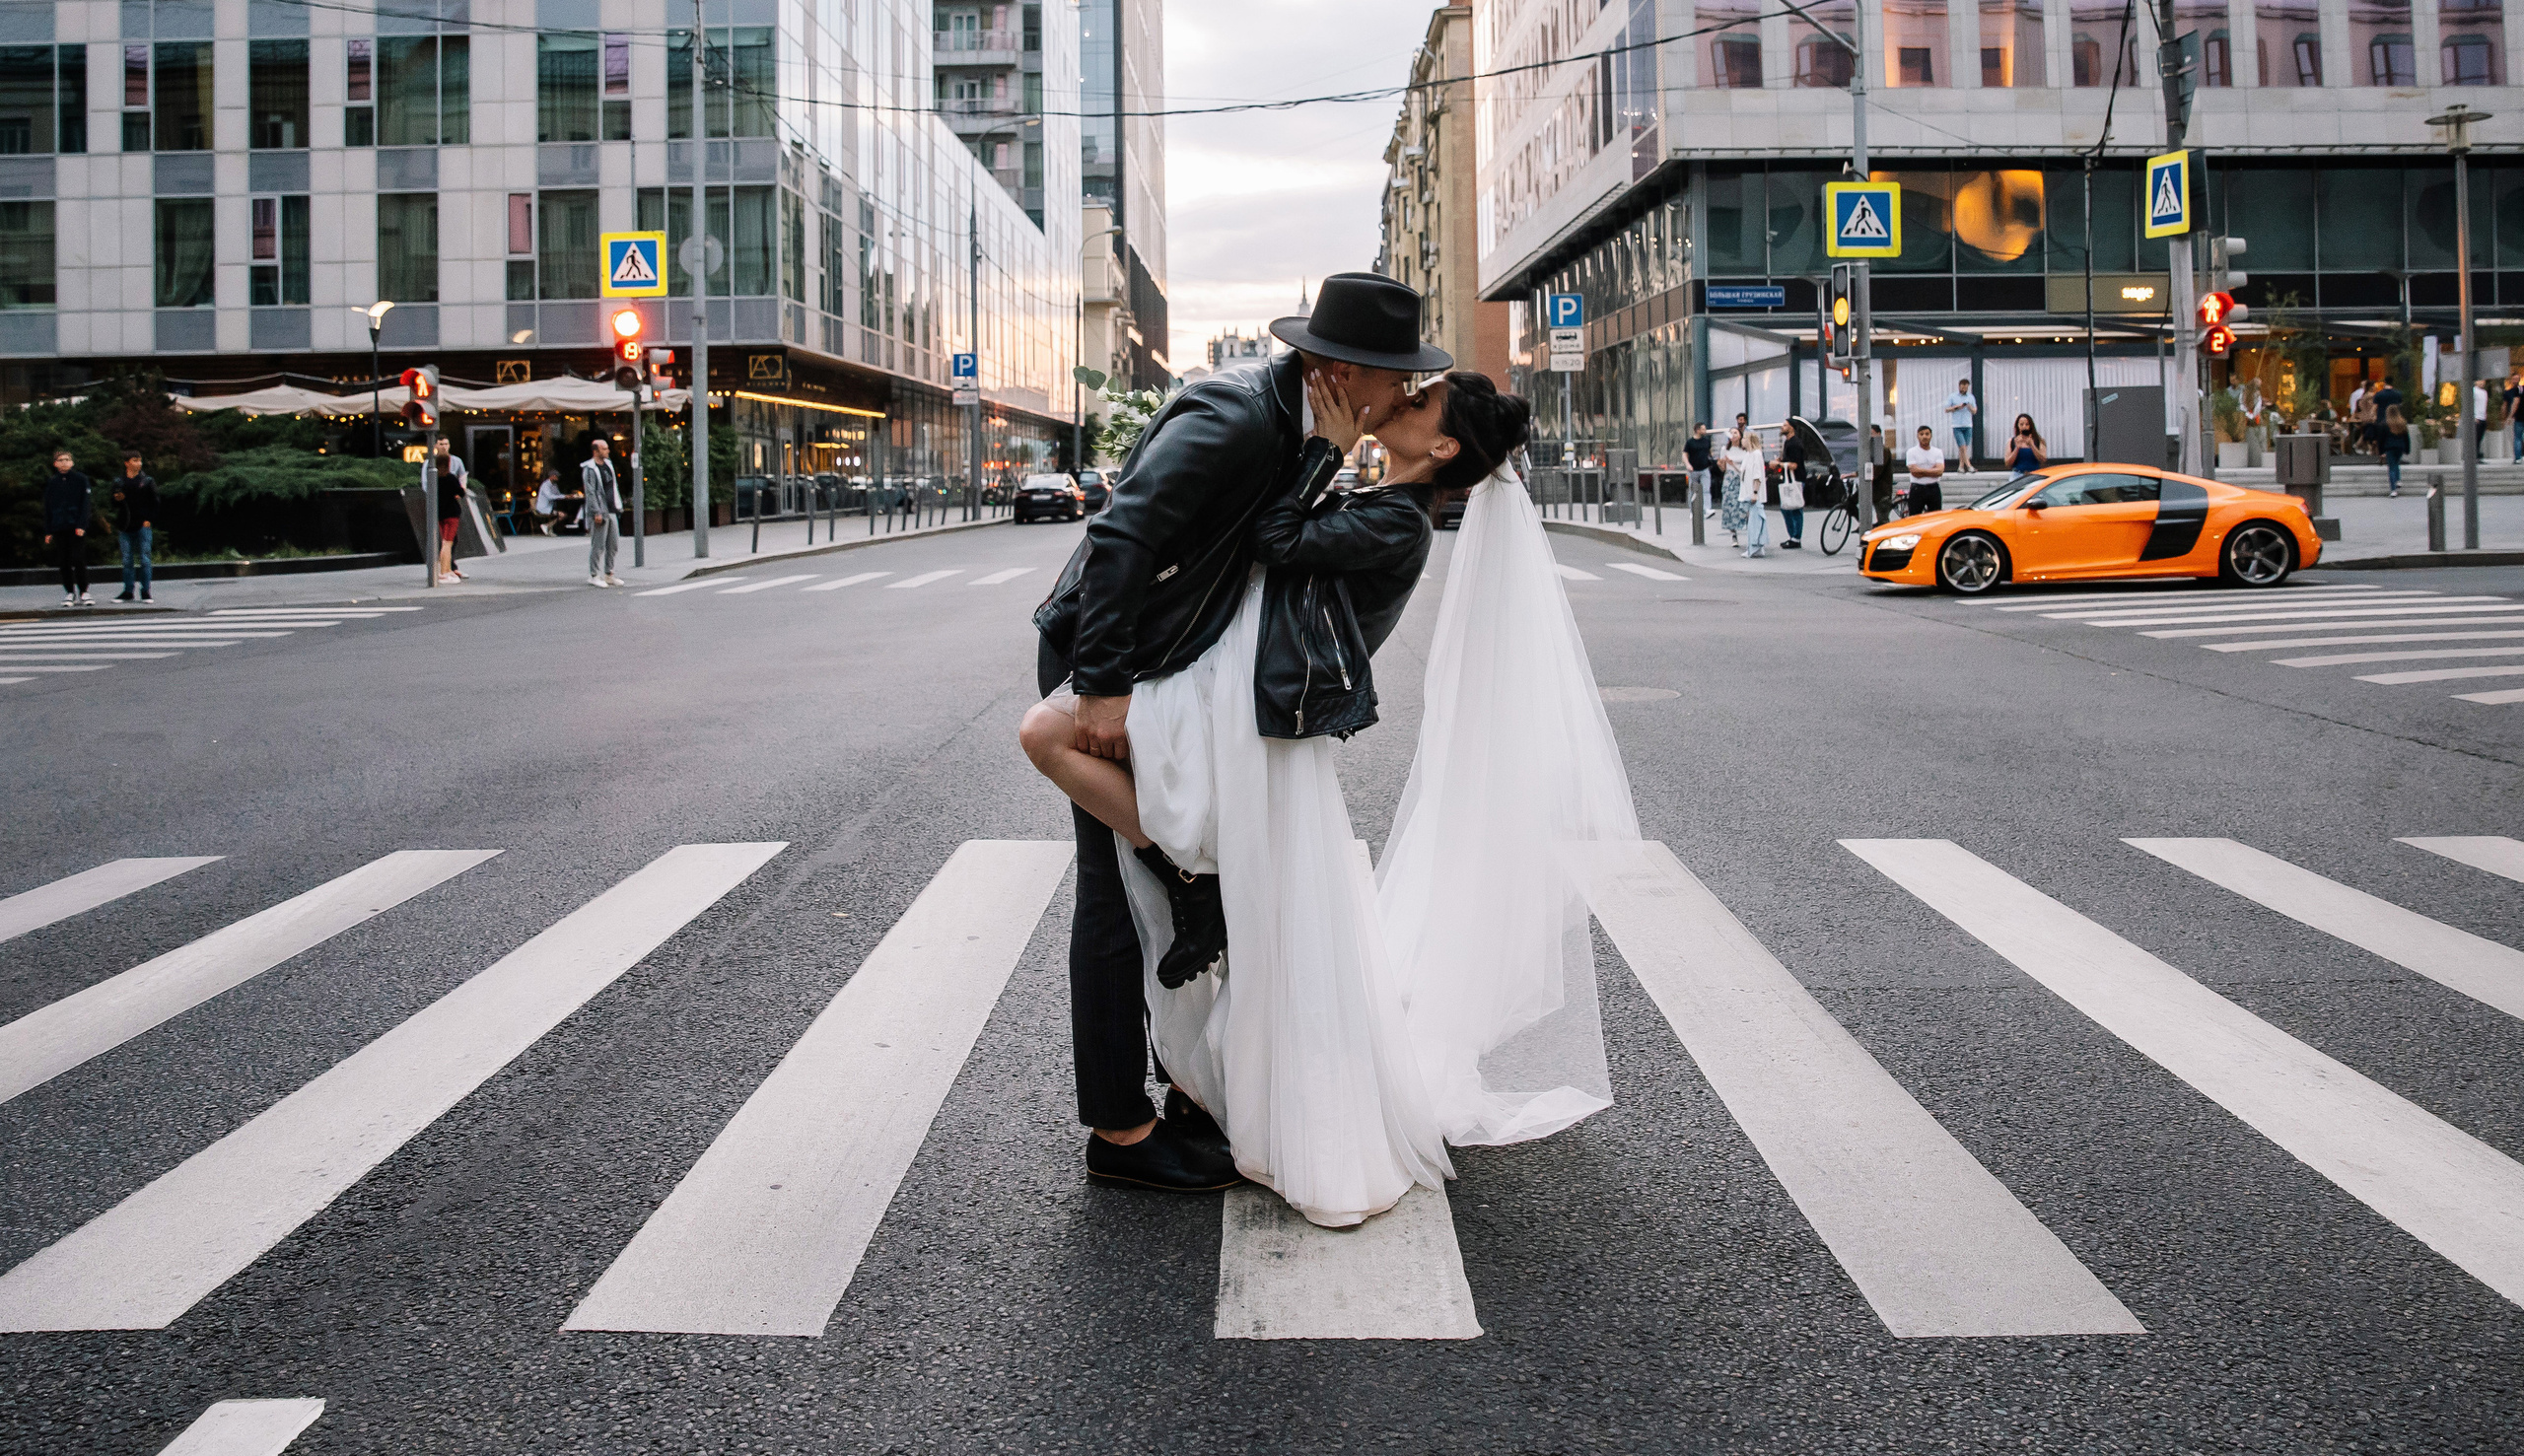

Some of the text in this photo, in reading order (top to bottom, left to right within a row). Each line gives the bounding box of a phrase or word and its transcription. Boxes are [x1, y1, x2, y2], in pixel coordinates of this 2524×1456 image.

[1558, 297, 1578, 325] P
[624, 341, 639, 360] 19
[2212, 332, 2225, 352] 2
[958, 355, 974, 376] P
